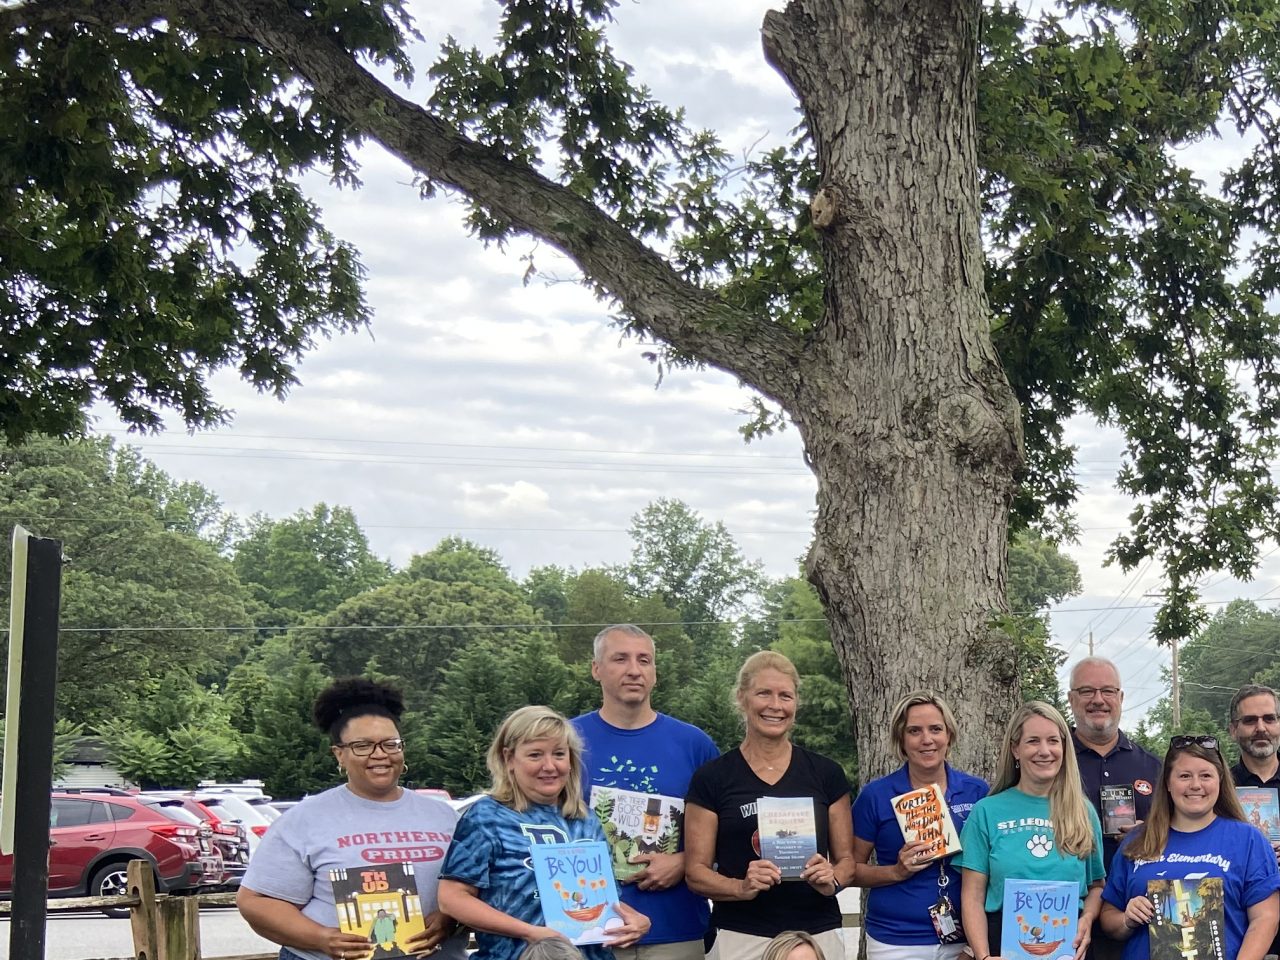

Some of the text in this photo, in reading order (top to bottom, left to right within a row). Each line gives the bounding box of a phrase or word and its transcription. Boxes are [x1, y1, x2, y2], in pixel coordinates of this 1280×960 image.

[896, 788, 937, 811] TURTLES
[1101, 789, 1132, 797] DUNE
[617, 803, 643, 816] GOES
[905, 804, 937, 821] ALL THE
[617, 815, 641, 828] WILD
[904, 812, 946, 833] WAY DOWN
[336, 831, 452, 849] NORTHERN
[917, 825, 942, 841] JOHN
[367, 847, 440, 860] PRIDE
[1166, 852, 1231, 873] Elementary
